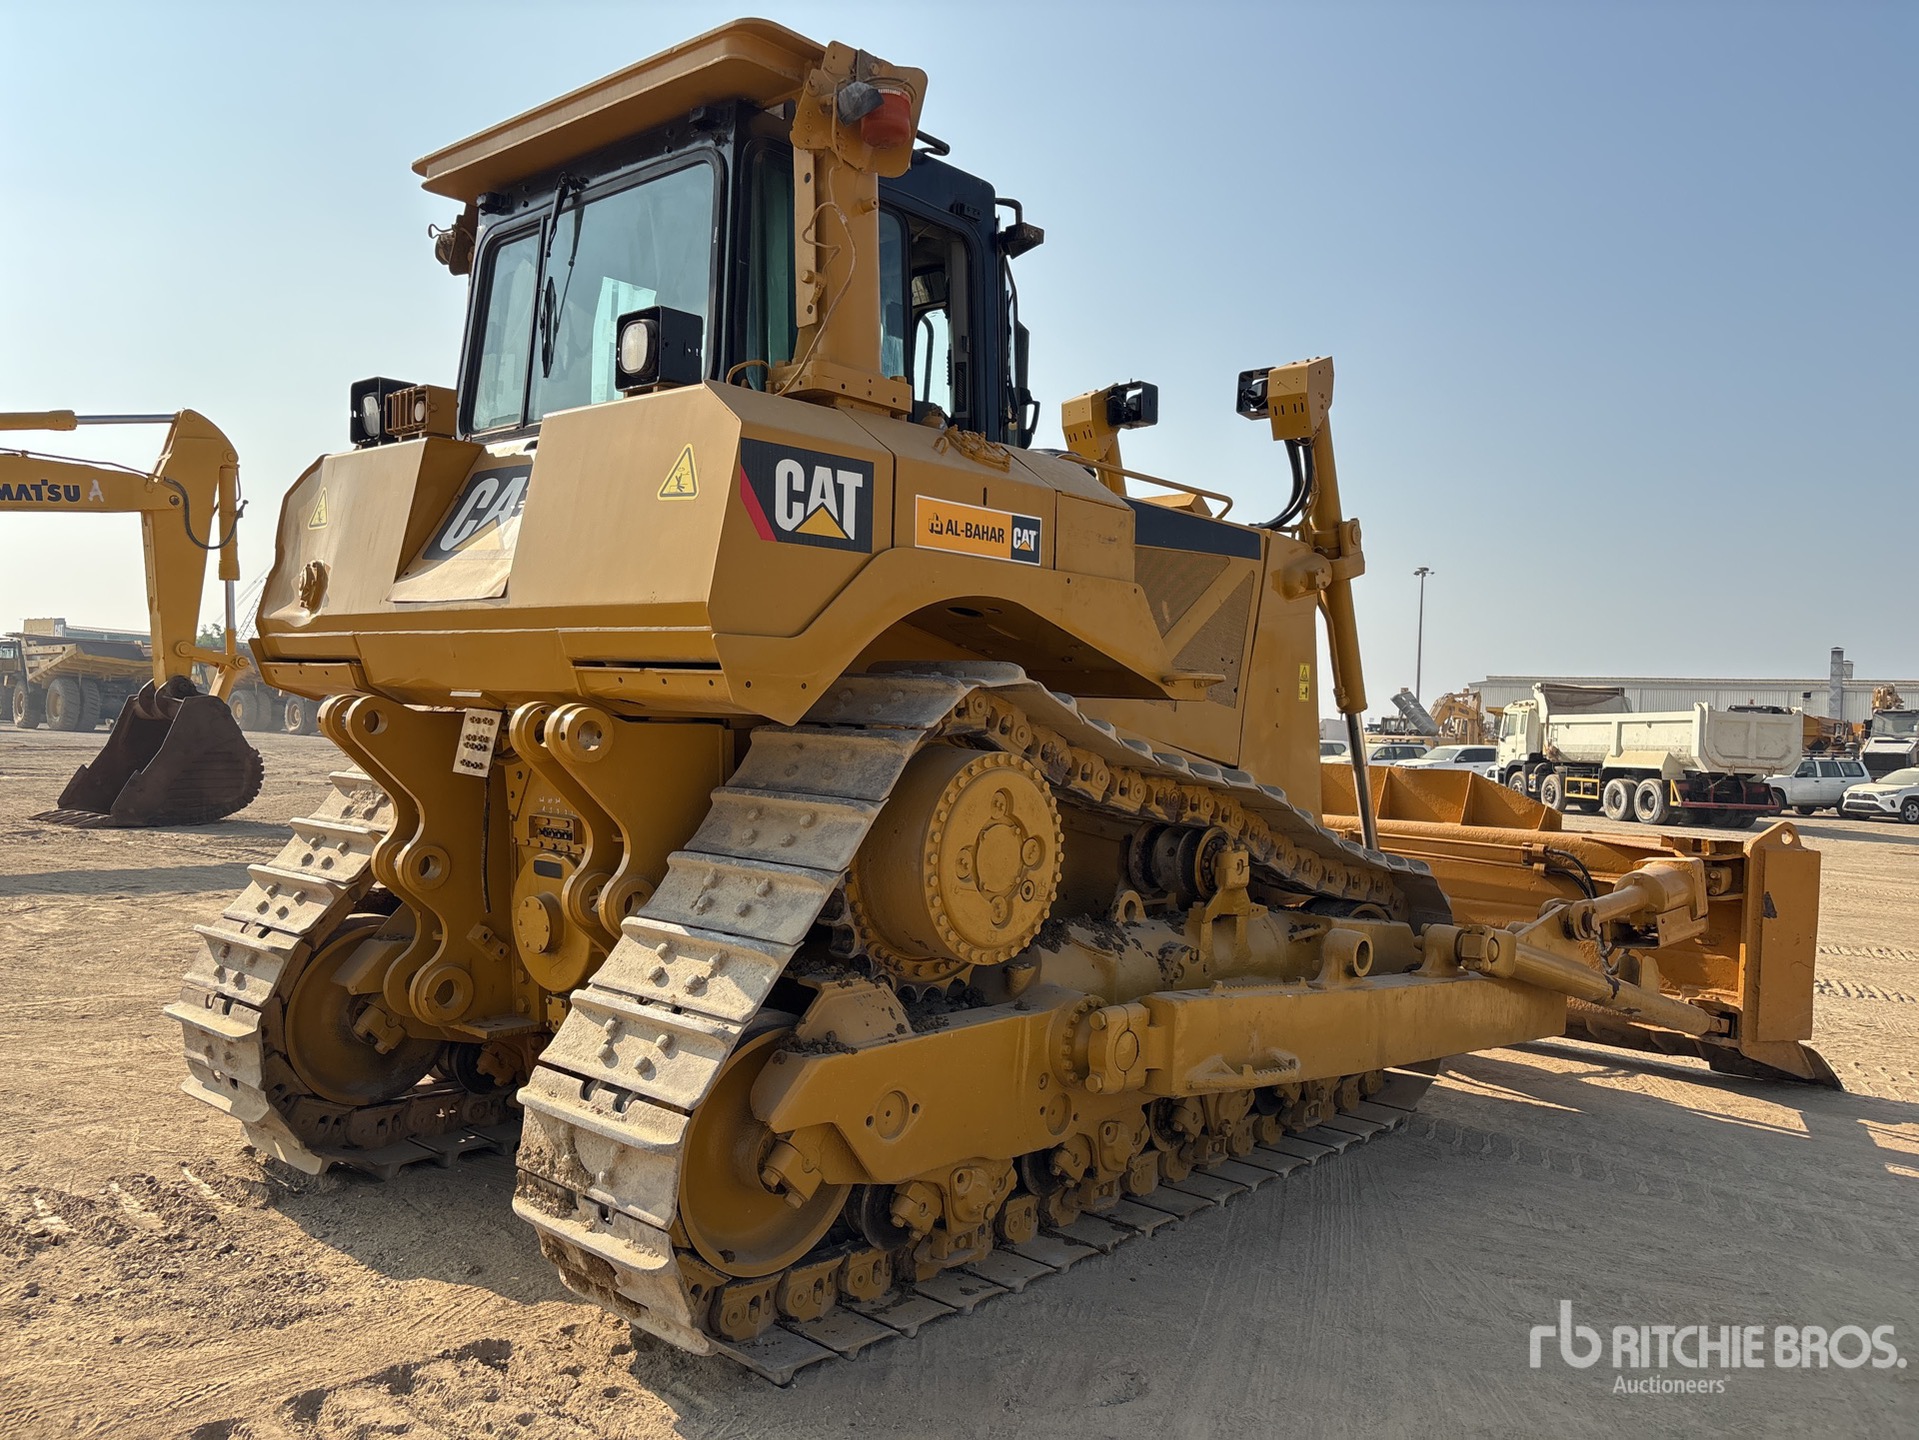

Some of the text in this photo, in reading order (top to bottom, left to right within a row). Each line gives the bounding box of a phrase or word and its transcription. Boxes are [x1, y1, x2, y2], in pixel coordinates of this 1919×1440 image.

[774, 458, 864, 541] CAT
[945, 518, 1005, 544] AL-BAHAR
[1012, 526, 1037, 552] CAT
